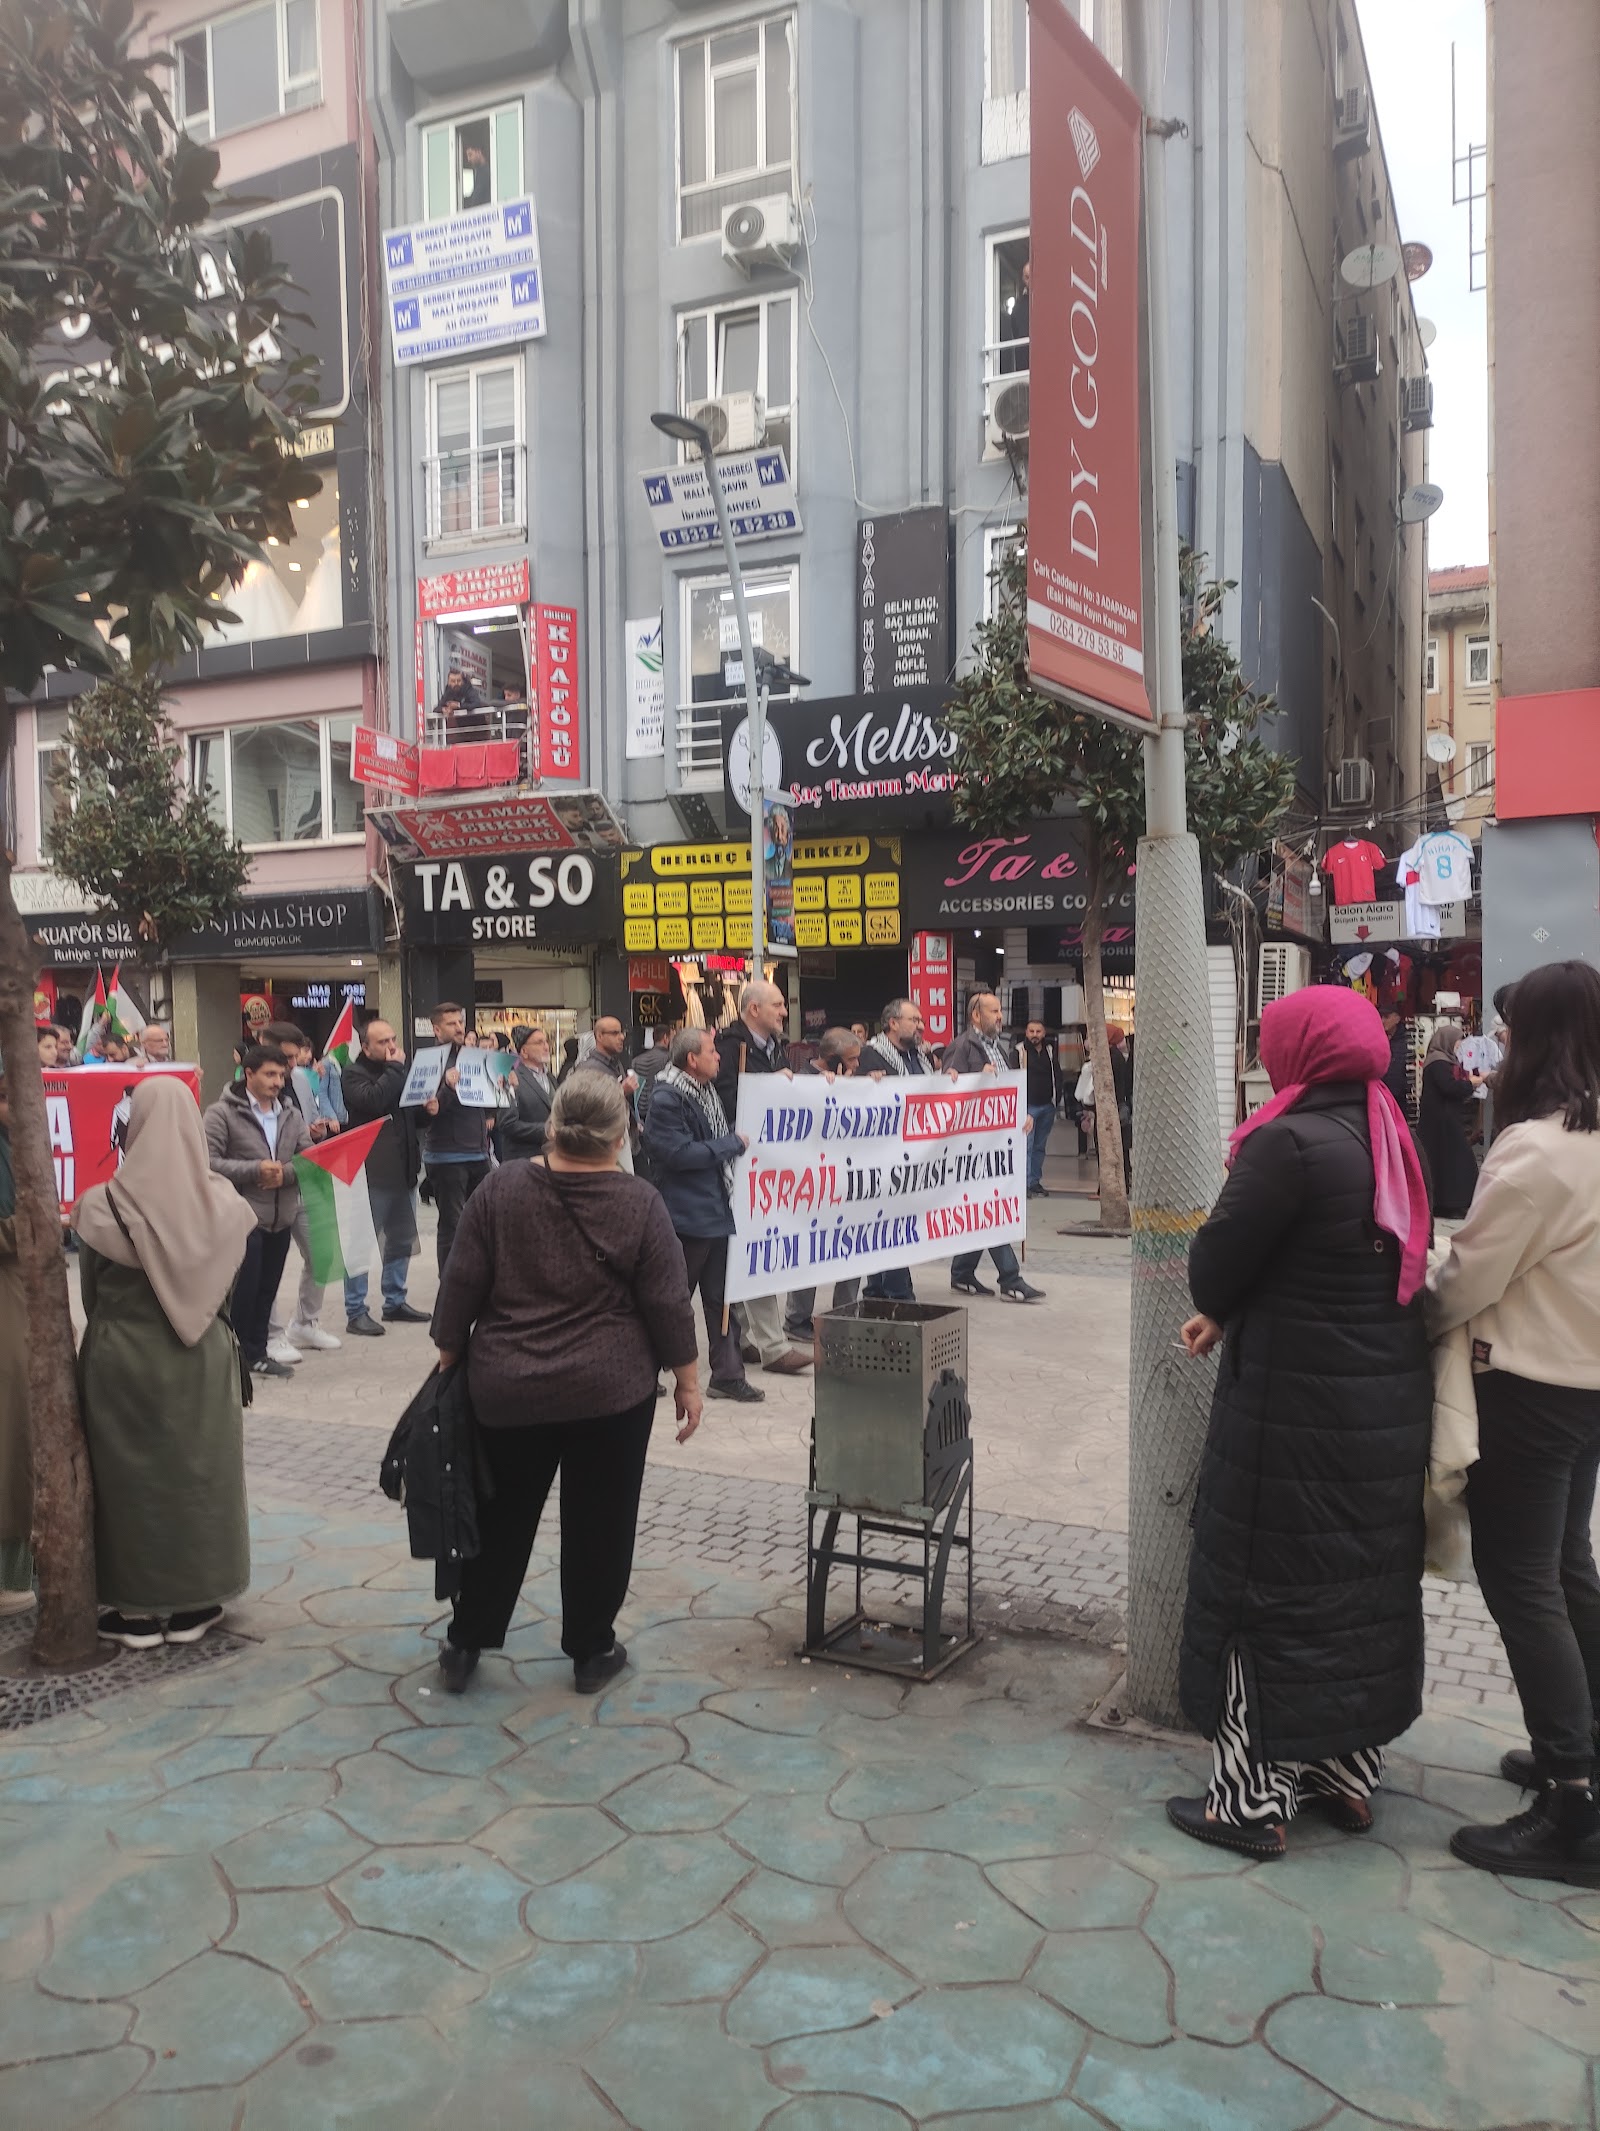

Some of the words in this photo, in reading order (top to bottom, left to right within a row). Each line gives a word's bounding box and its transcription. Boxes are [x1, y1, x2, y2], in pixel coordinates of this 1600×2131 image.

[415, 225, 449, 241] SERBEST
[425, 239, 447, 254] MALİ
[422, 289, 456, 307] SERBEST
[1070, 185, 1099, 430] GOLD
[432, 304, 455, 319] MALİ
[672, 471, 704, 486] SERBEST
[683, 487, 705, 501] MALİ
[1070, 437, 1099, 567] DY
[1033, 558, 1050, 579] Çark
[1051, 568, 1079, 595] Caddesi
[1101, 595, 1138, 625] ADAPAZARI
[884, 597, 911, 615] GELİN
[885, 615, 903, 630] SAÇ
[1050, 613, 1074, 641] 0264
[1077, 626, 1095, 650] 279
[1098, 636, 1110, 658] 53
[1112, 642, 1124, 664] 58
[548, 623, 572, 768] KUAFÖRÜ
[790, 782, 823, 808] Saç
[824, 778, 902, 802] Tasarım
[449, 804, 547, 823] YILMAZ
[458, 816, 553, 835] ERKEK
[426, 829, 562, 851] KUAFÖRÜ
[944, 833, 1037, 888] Ta
[1040, 852, 1078, 880] &
[1436, 855, 1452, 879] 8
[414, 861, 472, 912] TA
[484, 865, 520, 911] &
[528, 853, 594, 908] SO
[1335, 904, 1363, 916] Salon
[38, 921, 103, 946] KUAFÖR
[472, 915, 536, 940] STORE
[869, 931, 897, 942] ÇANTA
[758, 1106, 813, 1144] ABD
[821, 1093, 901, 1140] ÜSLERİ
[845, 1157, 882, 1202] İLE
[747, 1227, 799, 1277] TÜM
[808, 1209, 921, 1266] İLİŞKİLER
[925, 1188, 1021, 1243] KESİLSİN!
